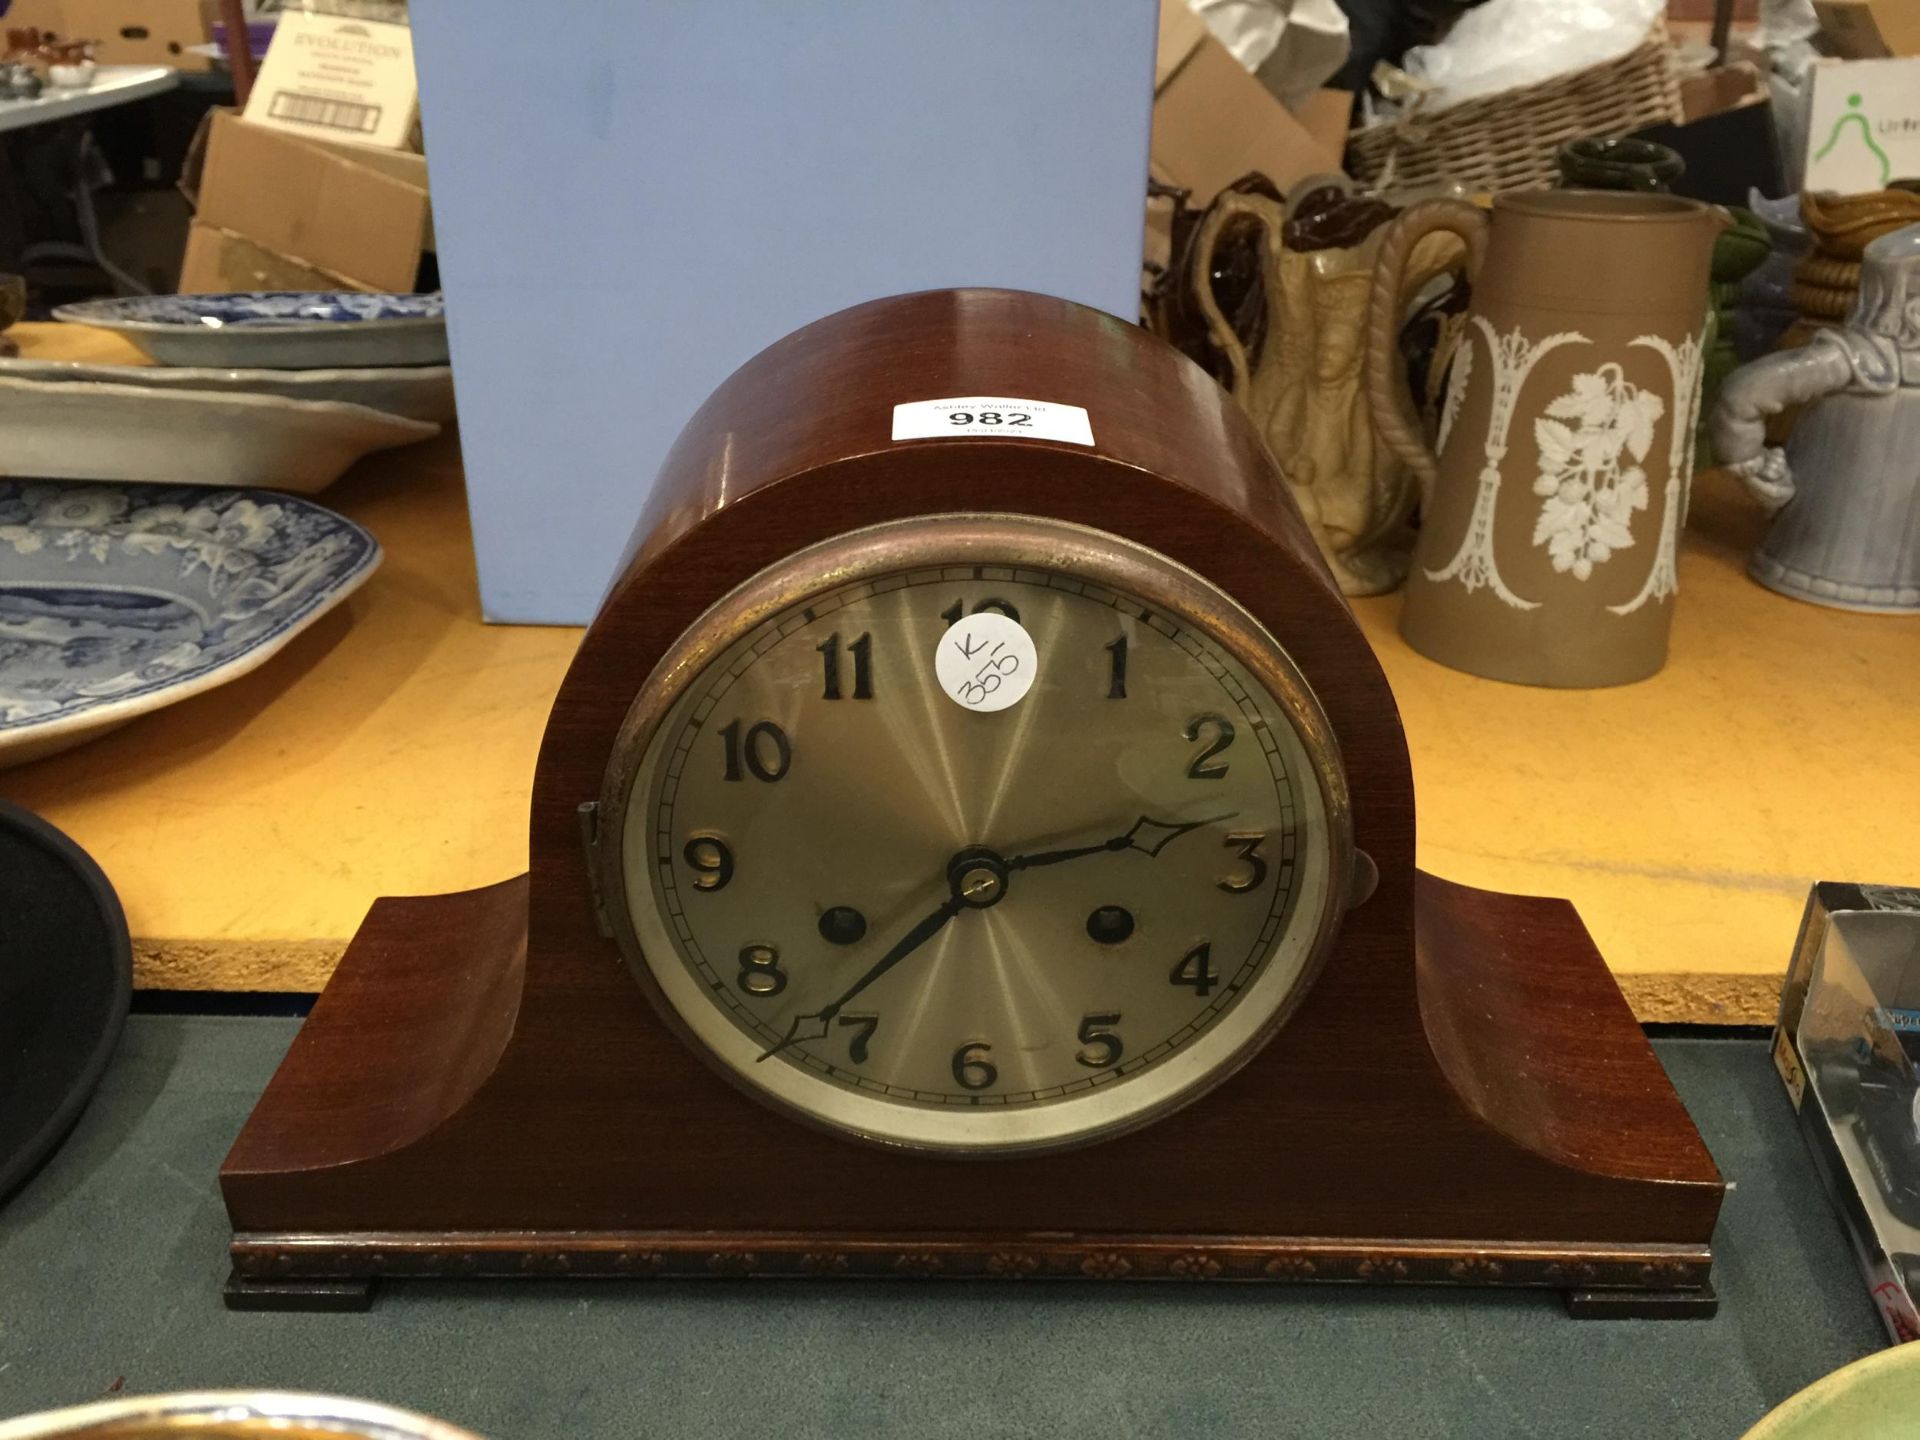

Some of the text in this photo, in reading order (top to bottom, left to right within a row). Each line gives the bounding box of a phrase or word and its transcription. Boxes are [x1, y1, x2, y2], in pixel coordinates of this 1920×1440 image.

[949, 412, 1033, 427] 982
[815, 631, 874, 700] 11
[954, 633, 989, 660] K
[957, 642, 1020, 705] 355
[1105, 633, 1129, 700] 1
[717, 720, 792, 783] 10
[1185, 714, 1236, 780] 2
[683, 833, 734, 893] 9
[1216, 834, 1269, 894] 3
[736, 944, 788, 998] 8
[1168, 941, 1220, 998] 4
[837, 1014, 879, 1065] 7
[951, 1042, 998, 1090] 6
[1076, 1014, 1123, 1068] 5
